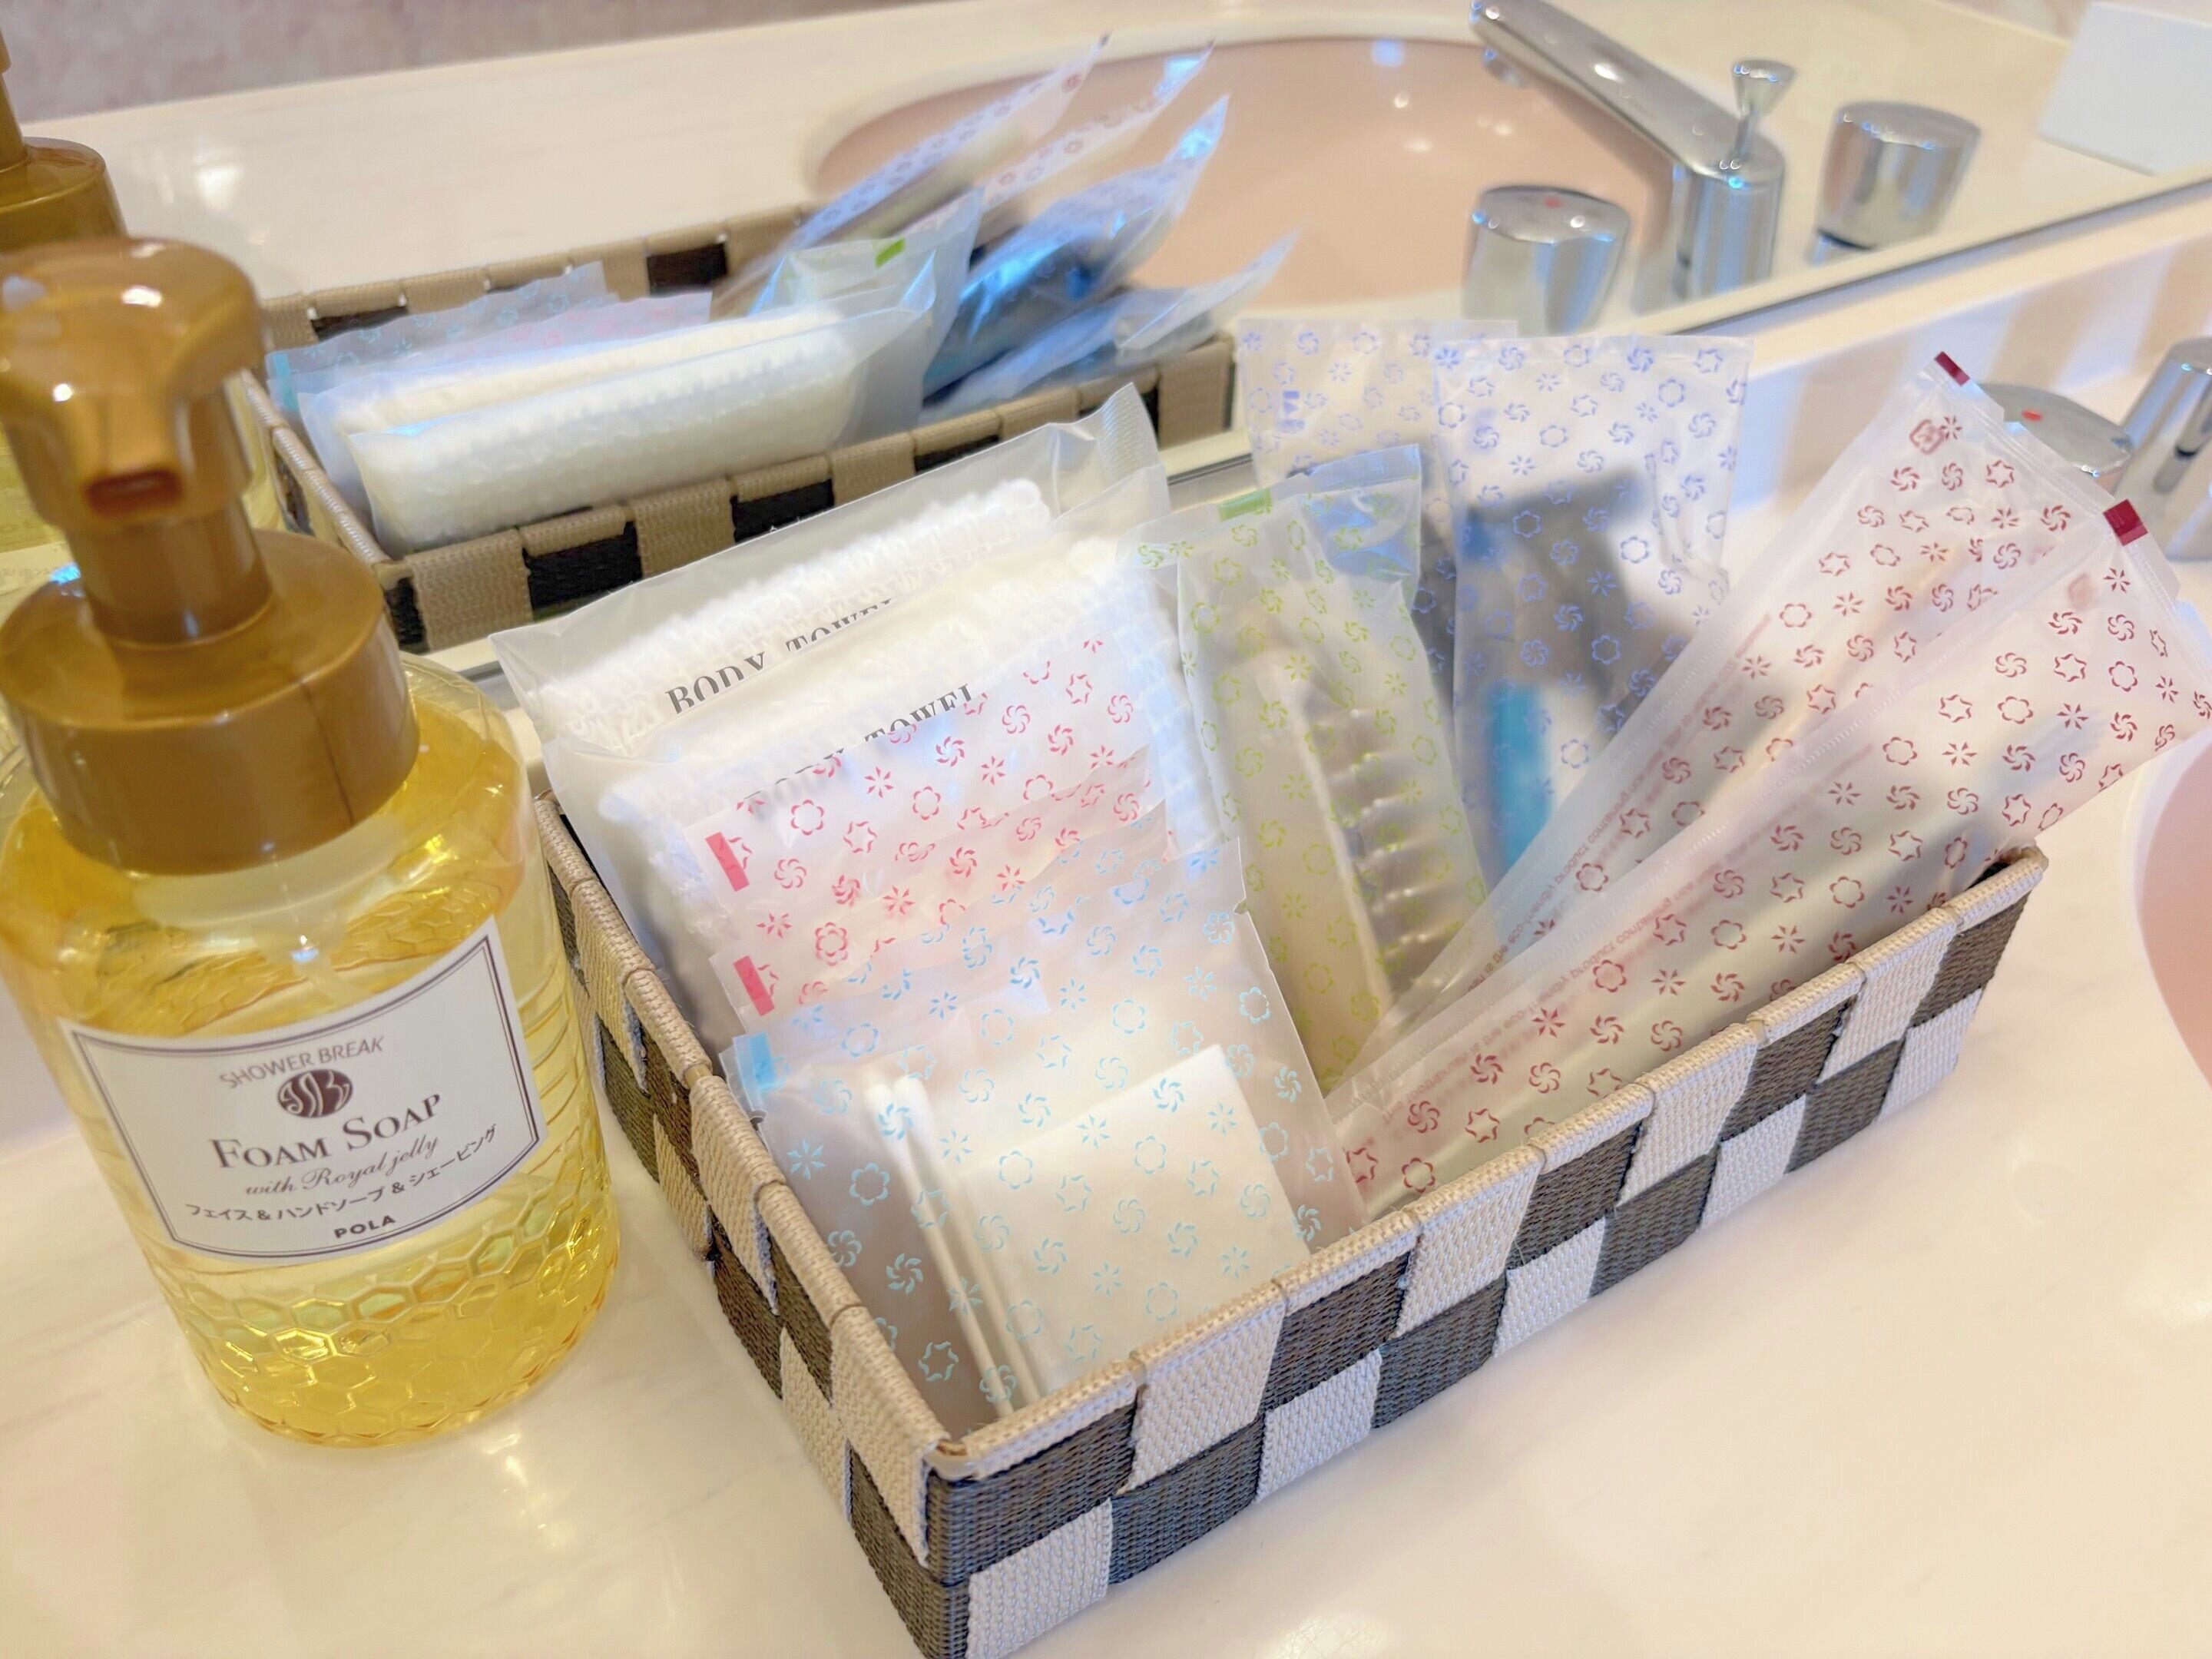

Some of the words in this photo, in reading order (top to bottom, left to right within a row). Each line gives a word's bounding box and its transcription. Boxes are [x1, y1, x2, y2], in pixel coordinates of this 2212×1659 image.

[220, 1051, 315, 1090] SHOWER
[318, 1035, 385, 1065] BREAK
[209, 1137, 333, 1168] FOAM
[342, 1093, 441, 1151] SOAP
[245, 1177, 298, 1196] with
[302, 1151, 388, 1190] Royal
[386, 1133, 439, 1177] jelly
[334, 1214, 397, 1239] POLA
